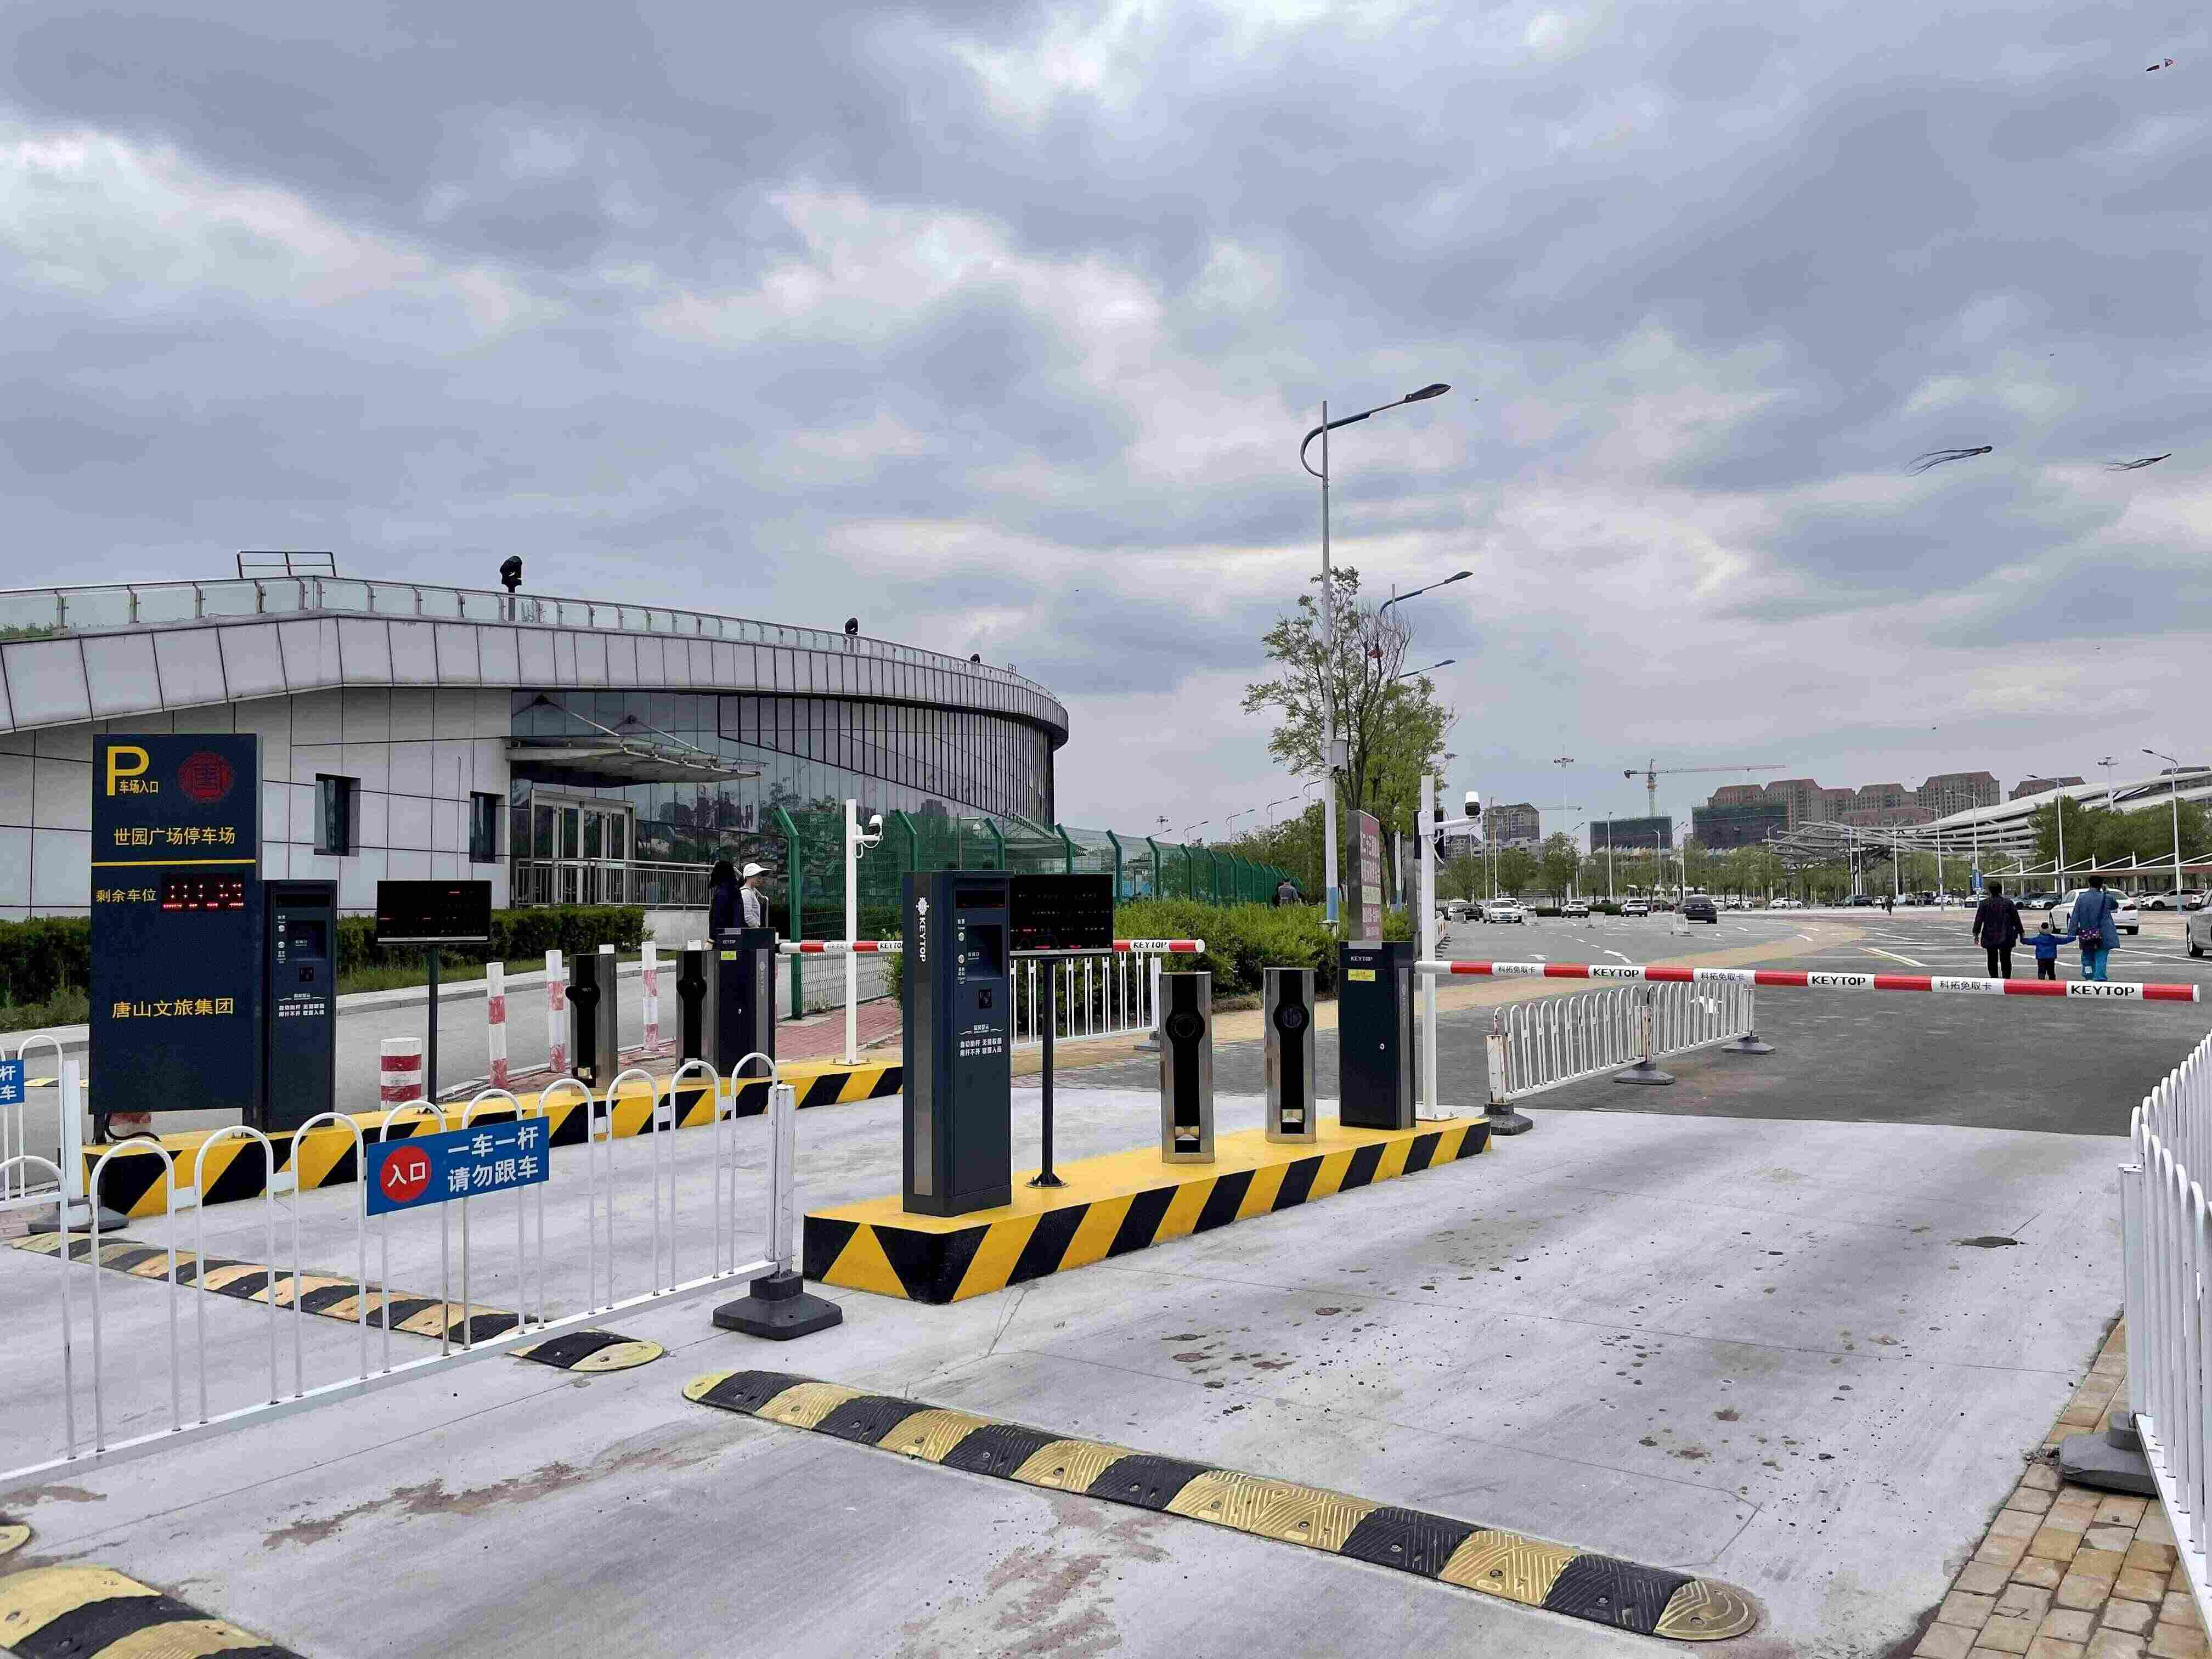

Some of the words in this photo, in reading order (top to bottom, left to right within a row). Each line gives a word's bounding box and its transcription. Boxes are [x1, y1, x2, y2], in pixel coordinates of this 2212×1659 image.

[106, 746, 150, 796] P
[119, 780, 159, 794] 车场入口
[114, 827, 236, 846] 世园广场停车场
[96, 888, 157, 903] 剩余车位
[1133, 940, 1167, 950] KEYTOP
[1593, 968, 1640, 978] KEYTOP
[1812, 975, 1866, 986] KEYTOP
[1940, 980, 1992, 991] 科拓免取卡
[2071, 985, 2135, 997] KEYTOP
[112, 997, 234, 1019] 唐山文旅集团
[448, 1126, 539, 1158] 一车一杆
[387, 1162, 426, 1188] 入口
[447, 1155, 539, 1193] 请勿跟车
